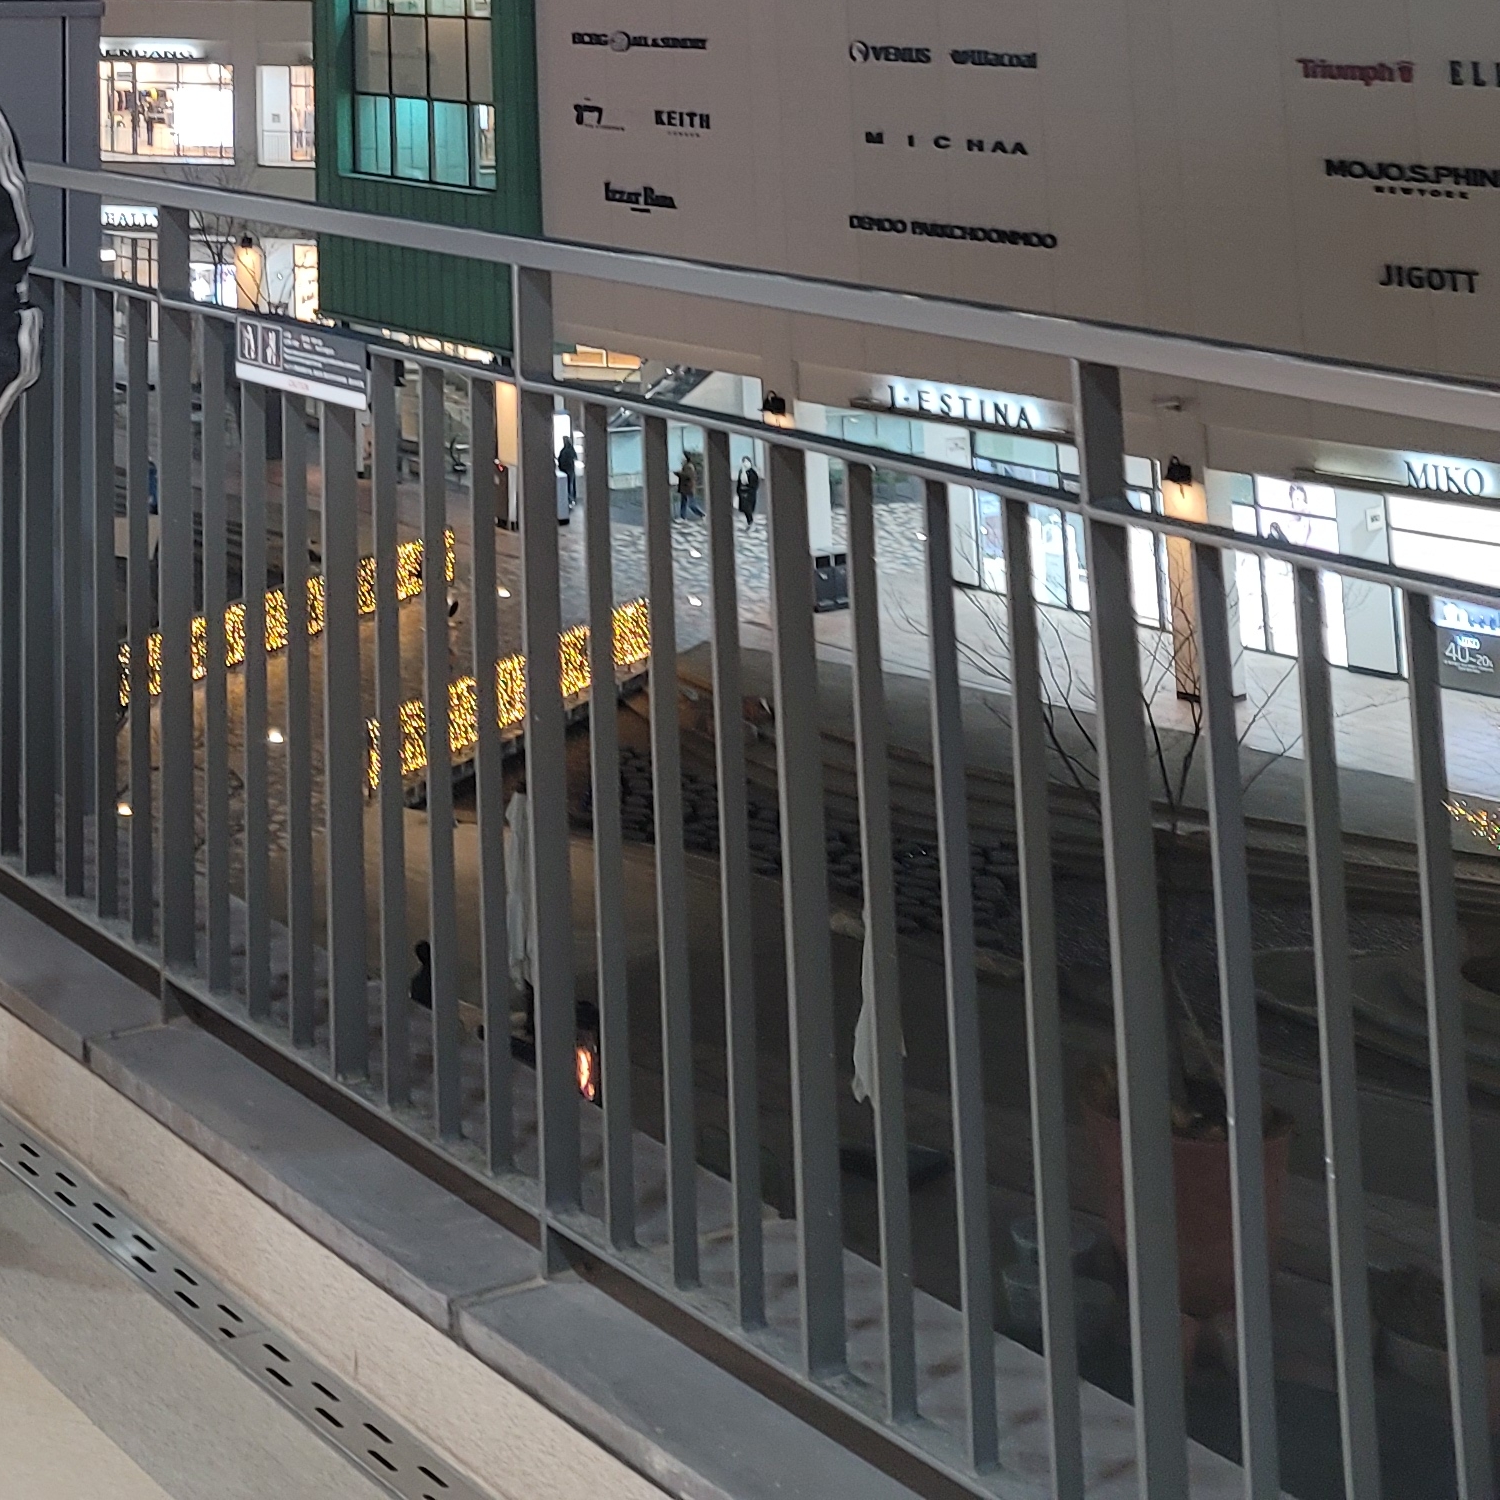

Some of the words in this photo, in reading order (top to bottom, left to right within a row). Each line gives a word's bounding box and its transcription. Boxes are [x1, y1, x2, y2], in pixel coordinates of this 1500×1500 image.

[1296, 57, 1396, 87] Triumph
[654, 109, 711, 130] KEITH
[1379, 263, 1480, 294] JIGOTT
[1403, 460, 1485, 497] MIKO
